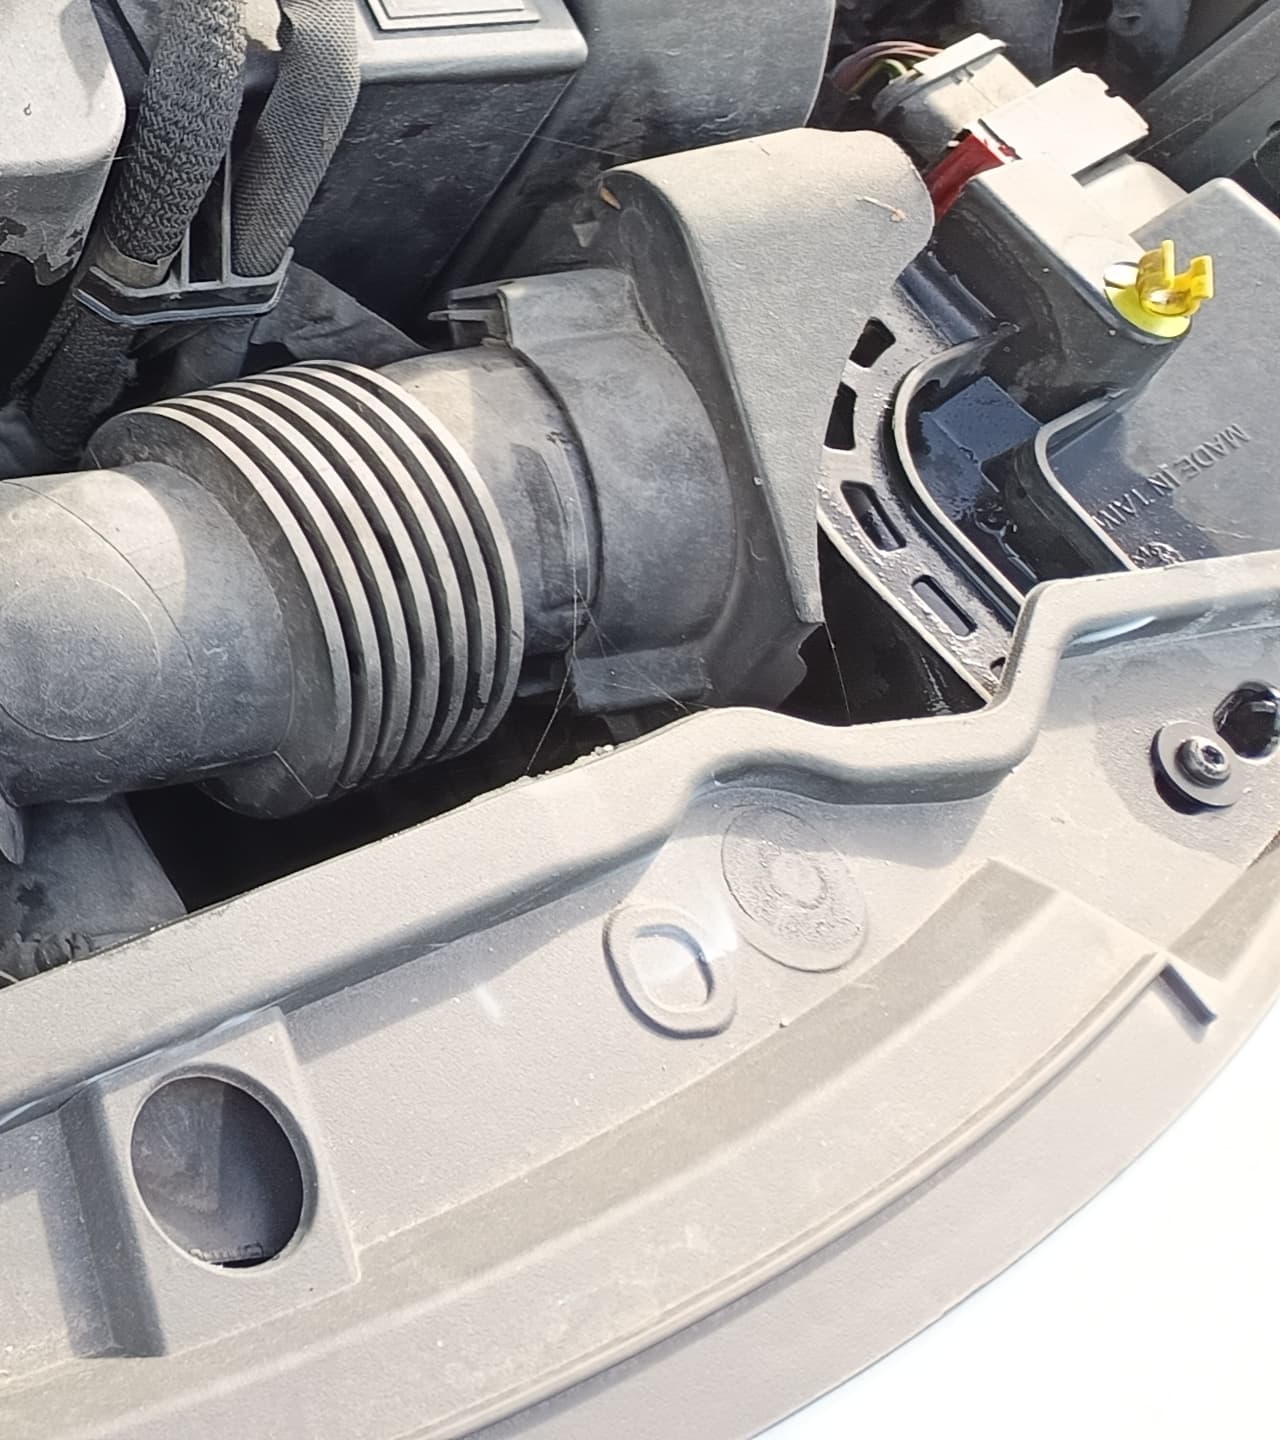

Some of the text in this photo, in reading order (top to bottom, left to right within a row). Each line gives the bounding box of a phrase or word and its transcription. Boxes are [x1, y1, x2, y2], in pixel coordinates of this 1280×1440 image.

[1090, 423, 1251, 532] MADE IN TAIW
